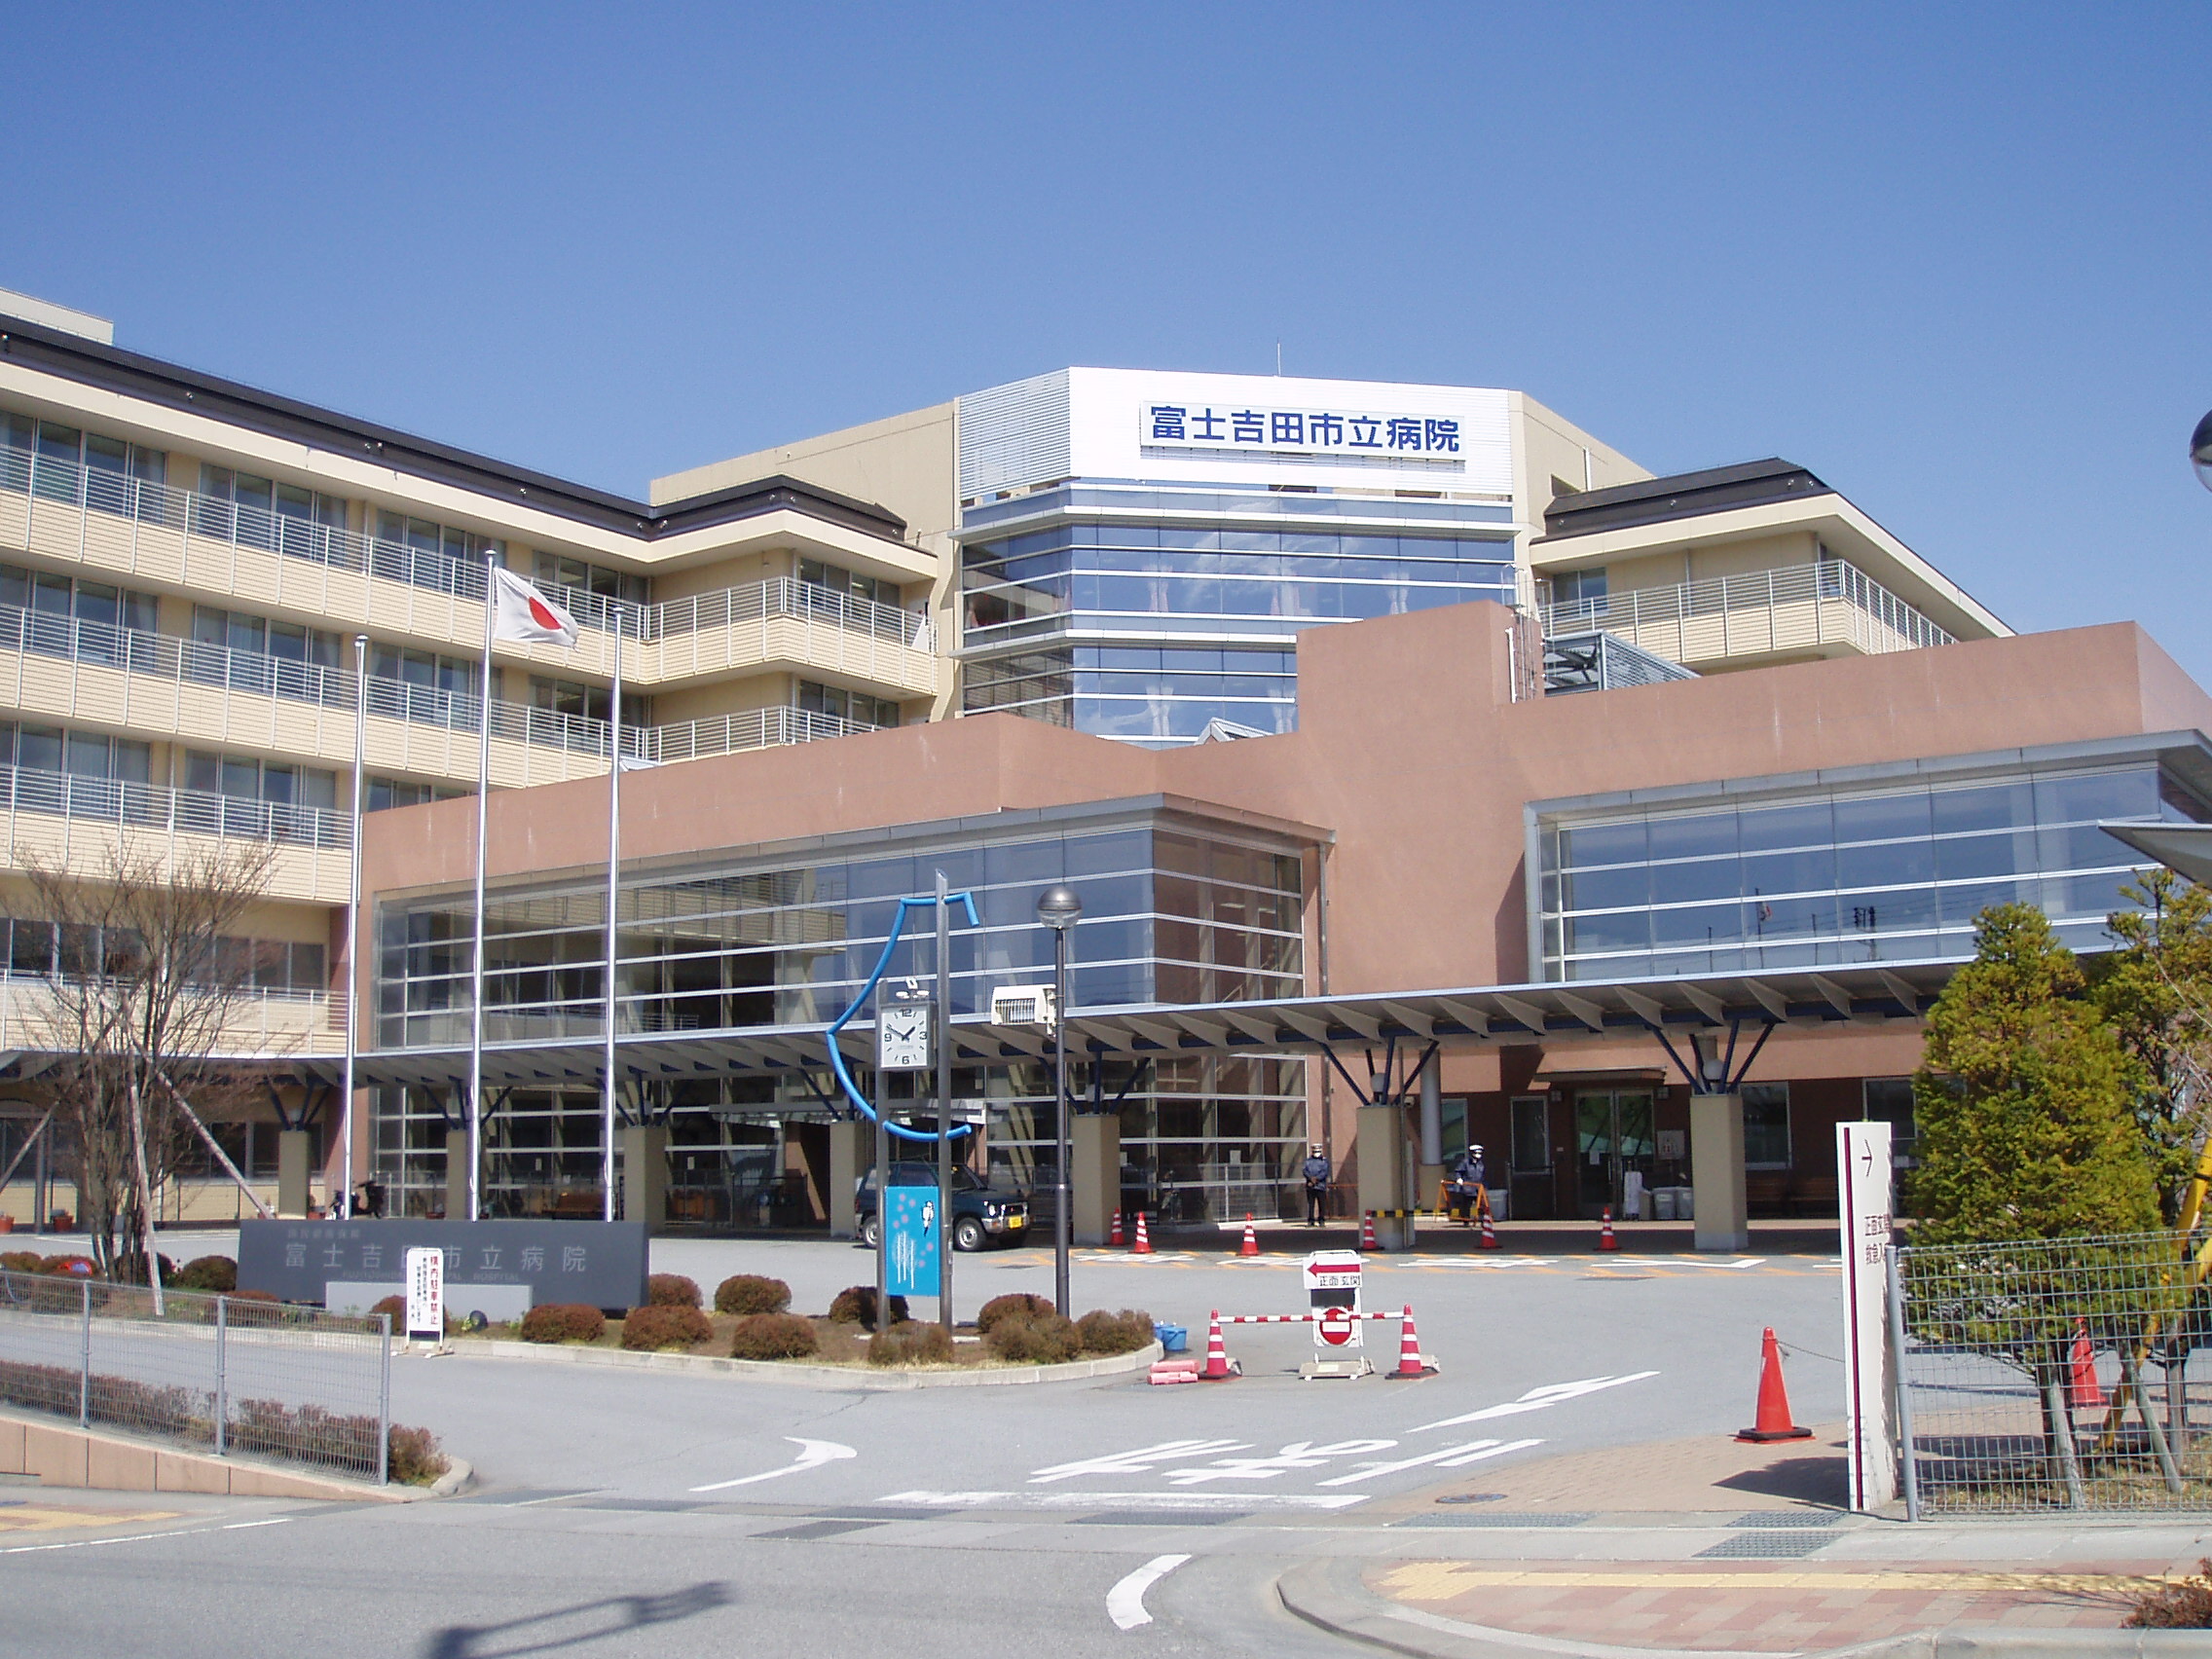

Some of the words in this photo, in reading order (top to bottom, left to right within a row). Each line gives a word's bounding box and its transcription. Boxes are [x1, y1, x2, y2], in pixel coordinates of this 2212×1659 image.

[1151, 405, 1459, 452] 富士吉田市立病院
[900, 1009, 912, 1017] 12
[884, 1033, 892, 1043] 9
[919, 1030, 928, 1040] 3
[902, 1055, 909, 1064] 6
[285, 1242, 587, 1272] 富士吉市立病院
